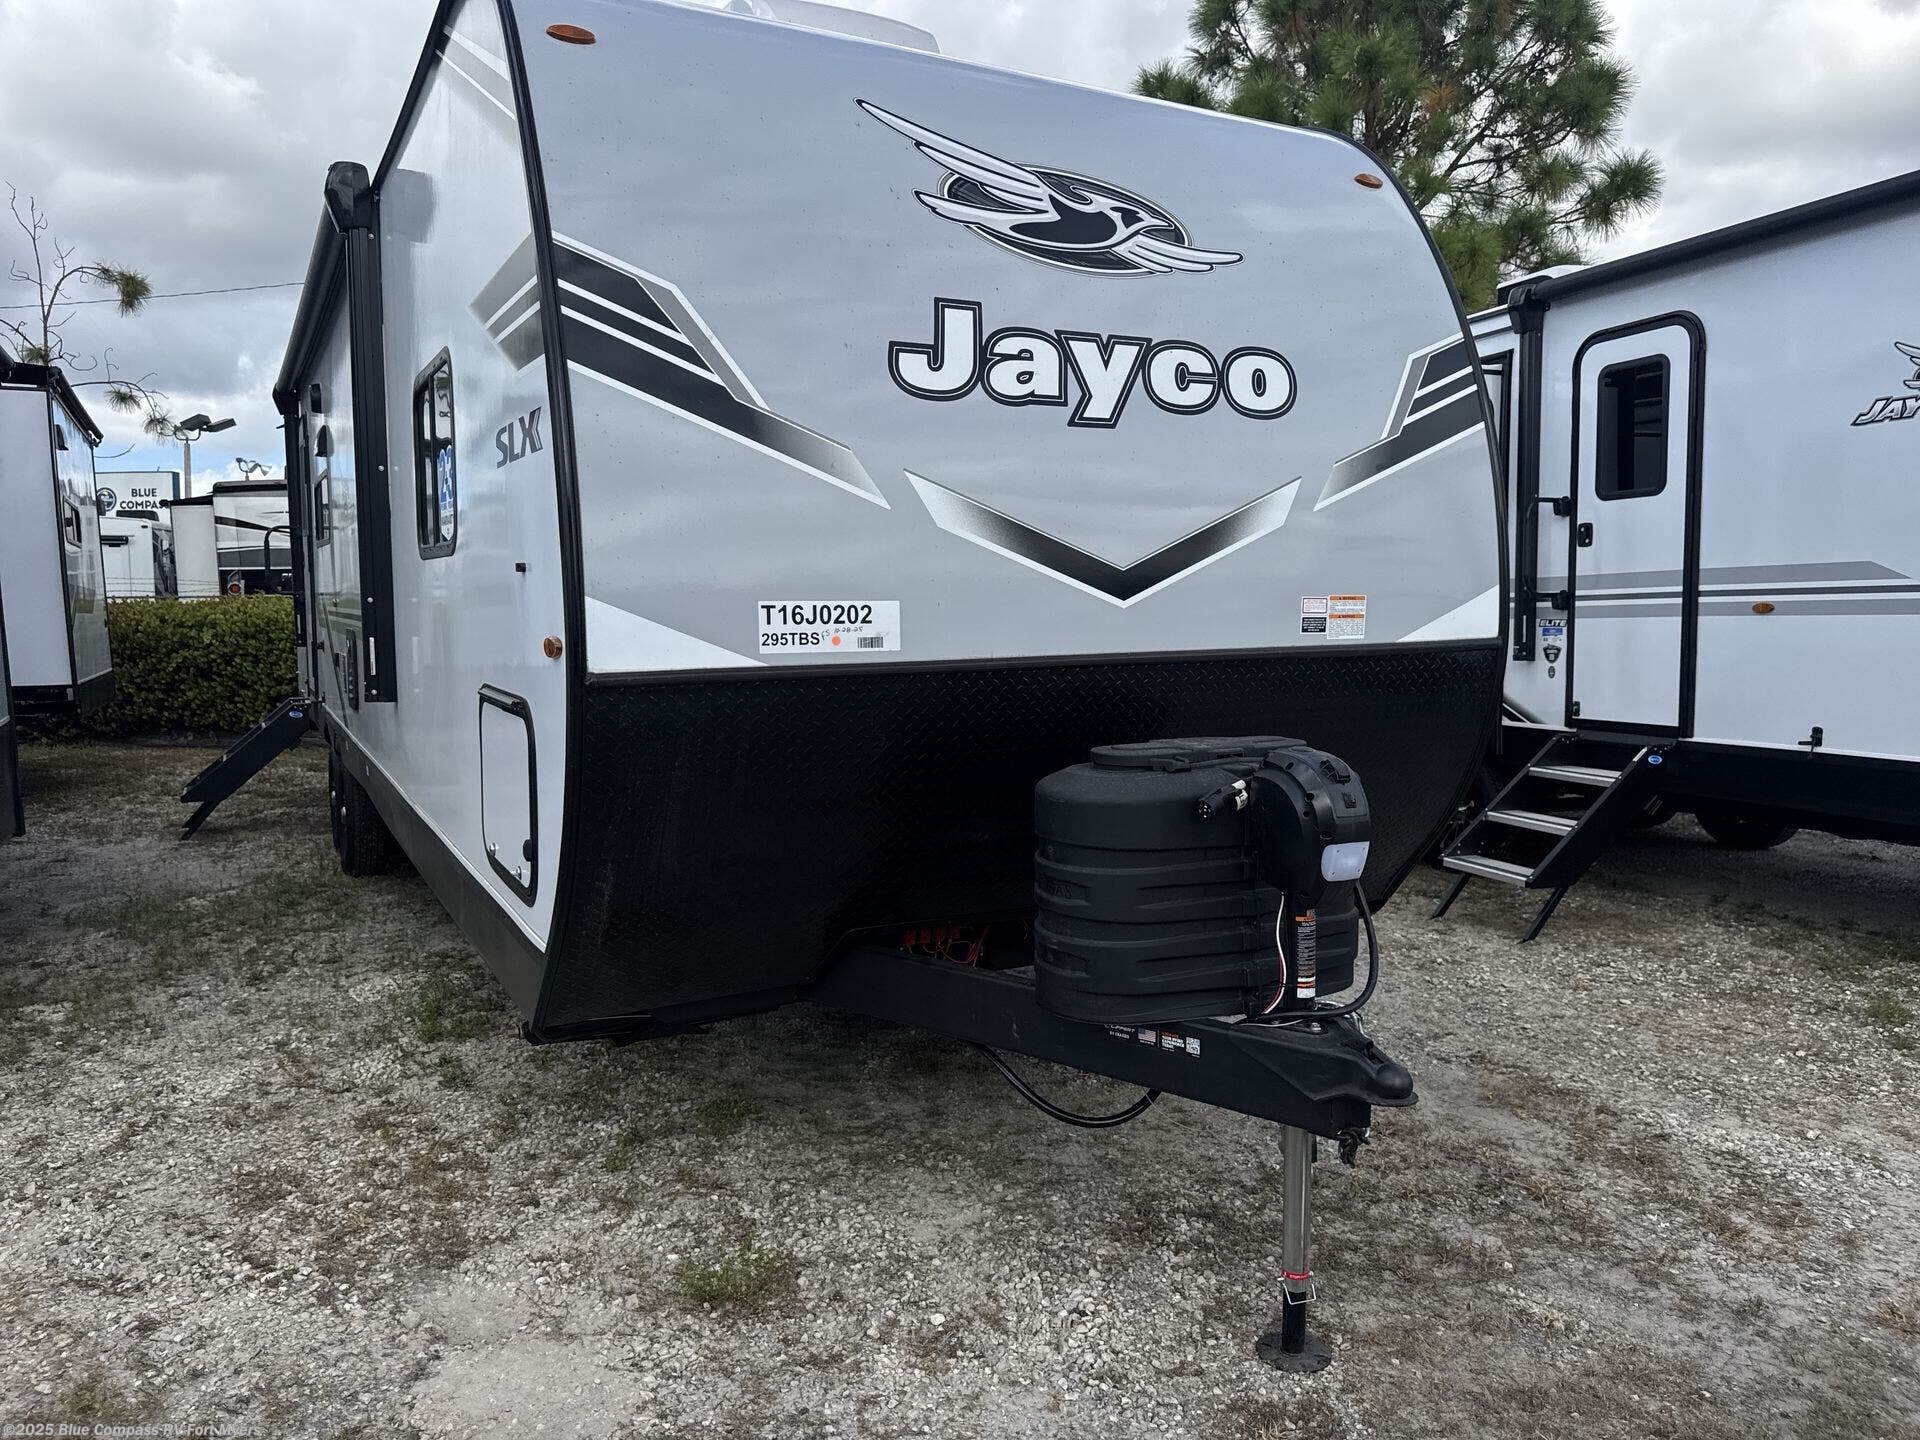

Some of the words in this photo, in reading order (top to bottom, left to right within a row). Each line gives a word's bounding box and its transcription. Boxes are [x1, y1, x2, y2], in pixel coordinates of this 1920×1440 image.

[888, 296, 1298, 429] Jayco
[496, 406, 544, 469] SLX
[131, 488, 158, 498] BLUE
[119, 500, 166, 511] COMPA
[761, 604, 873, 626] T16J0202
[1539, 619, 1567, 627] ELITE
[761, 632, 820, 647] 295TBS
